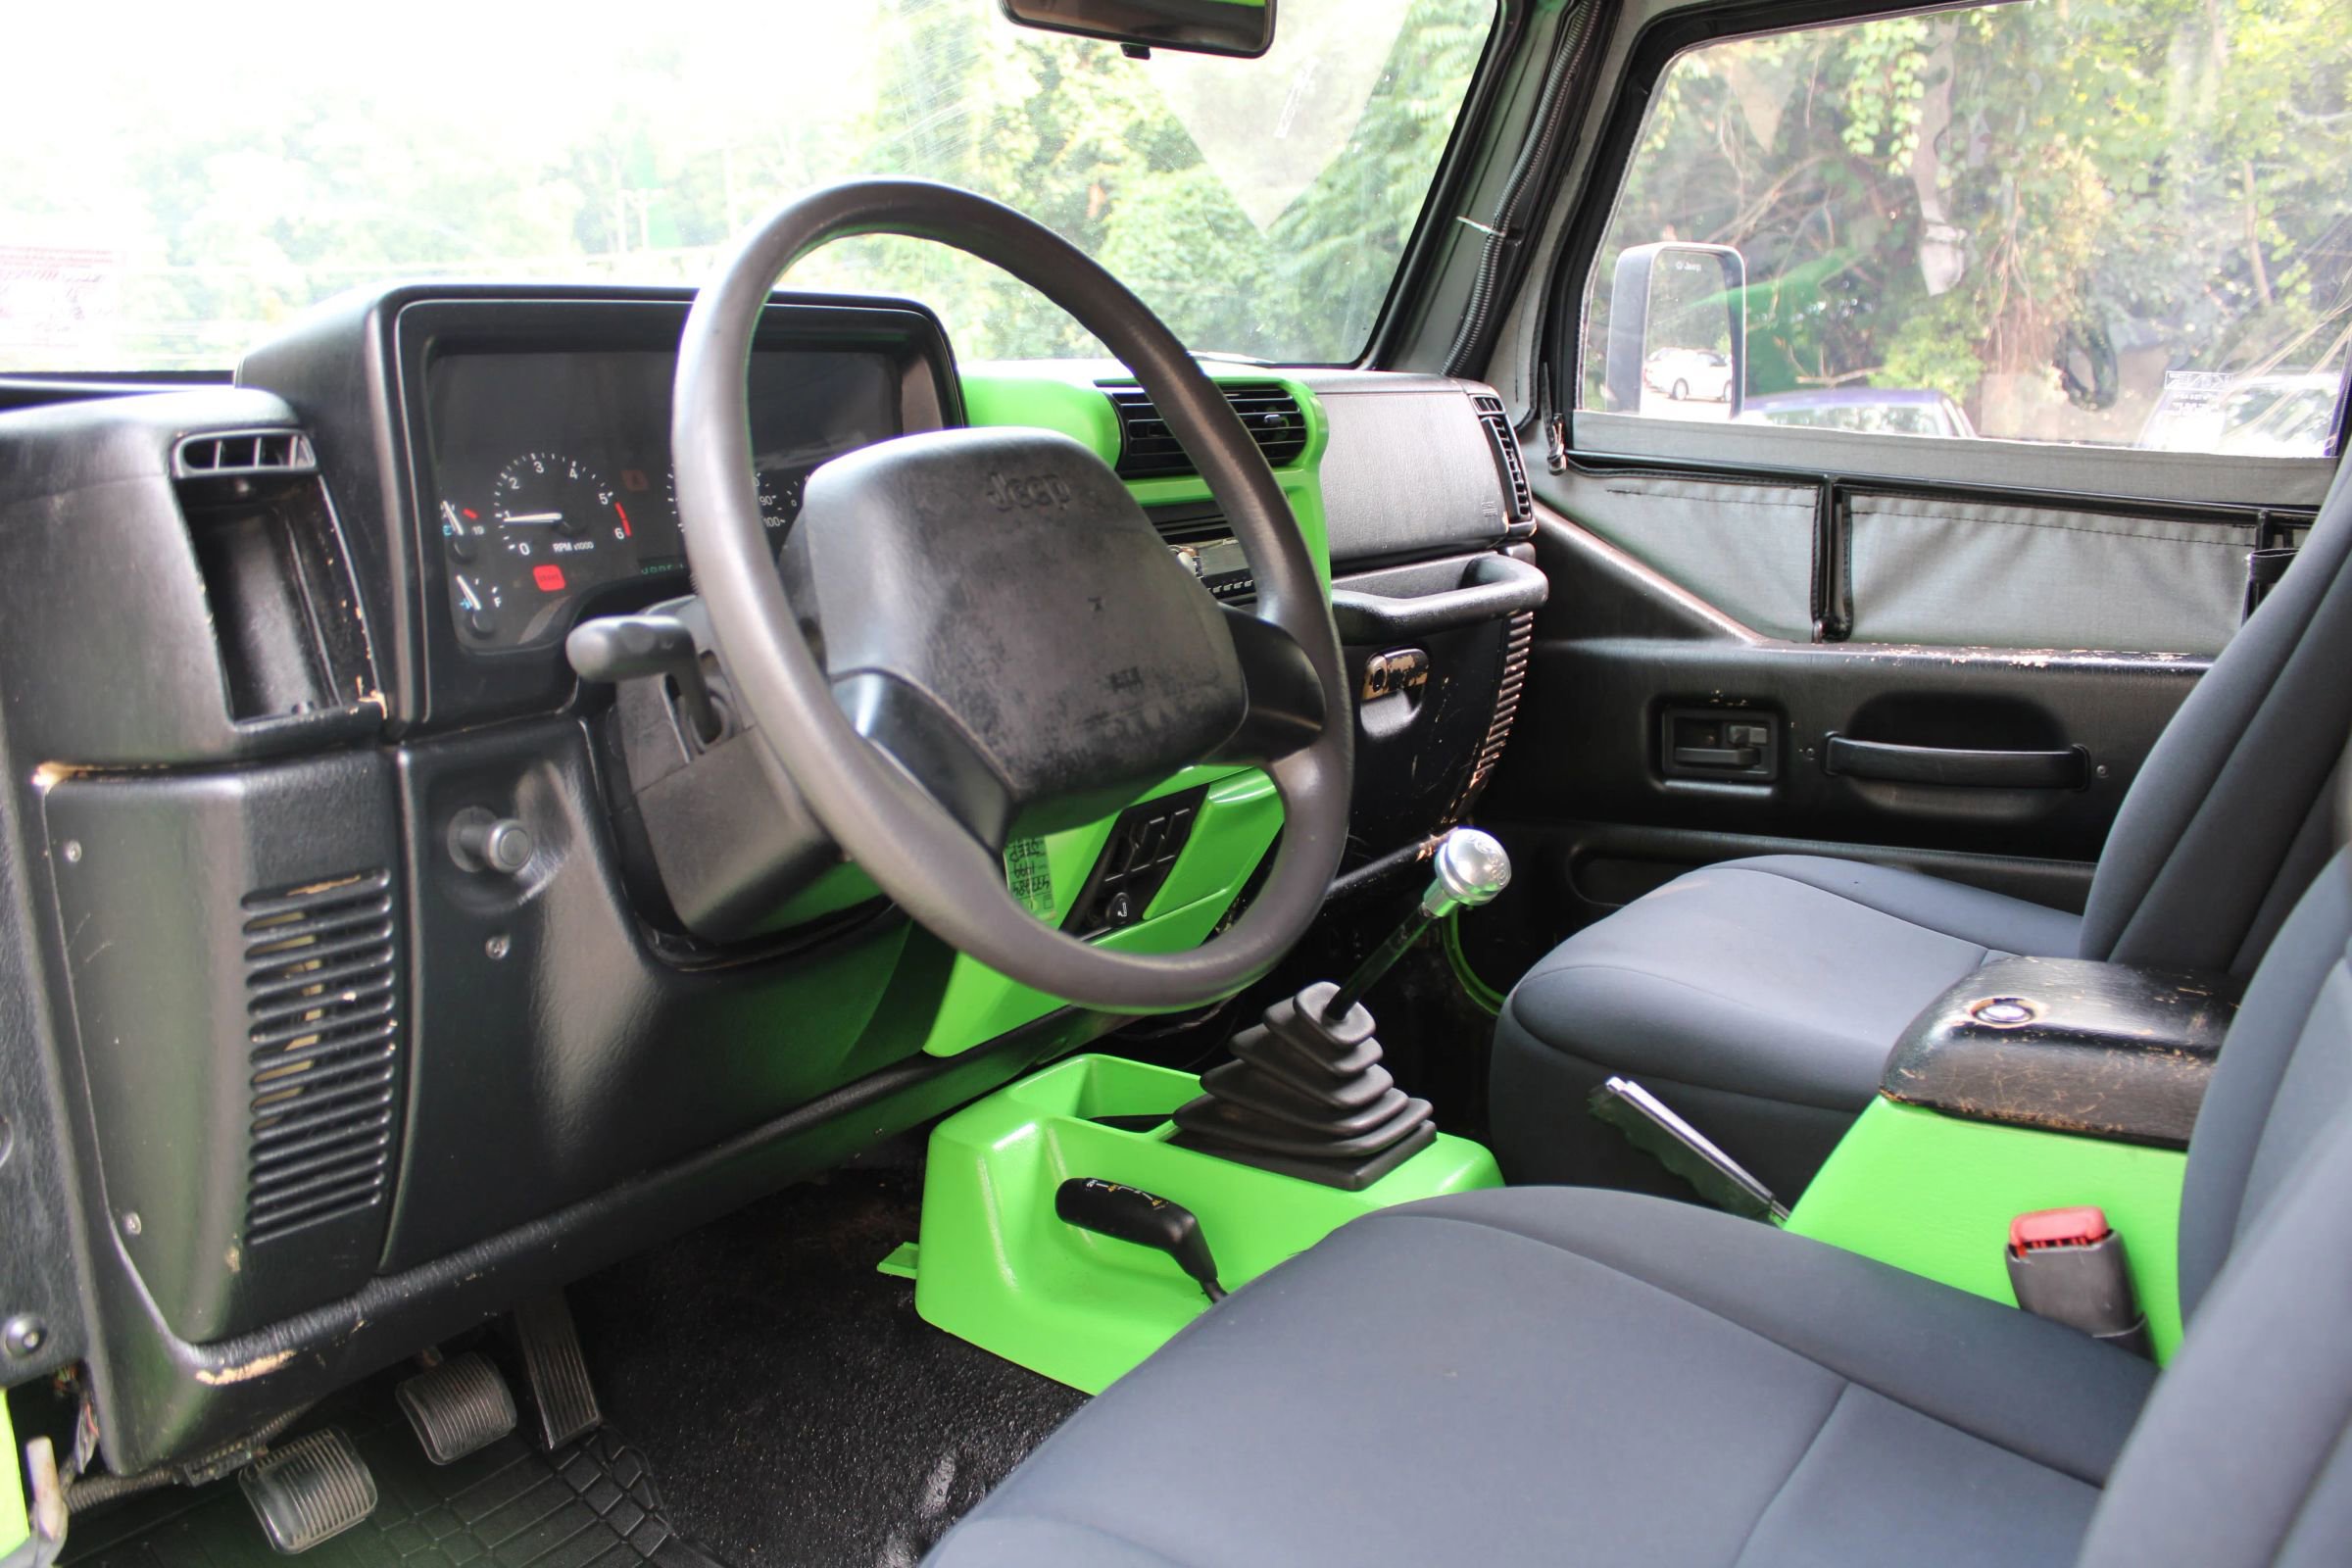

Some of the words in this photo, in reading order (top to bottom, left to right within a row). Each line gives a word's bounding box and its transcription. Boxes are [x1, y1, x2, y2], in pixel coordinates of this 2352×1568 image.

[533, 461, 545, 473] 3
[569, 467, 578, 479] 4
[509, 477, 520, 490] 2
[987, 472, 1071, 512] Jeep
[598, 493, 609, 506] 5
[759, 495, 773, 507] 90
[762, 515, 781, 528] 100
[614, 527, 625, 540] 6
[518, 542, 530, 556] 0
[552, 542, 573, 553] RPM
[493, 596, 502, 608] F
